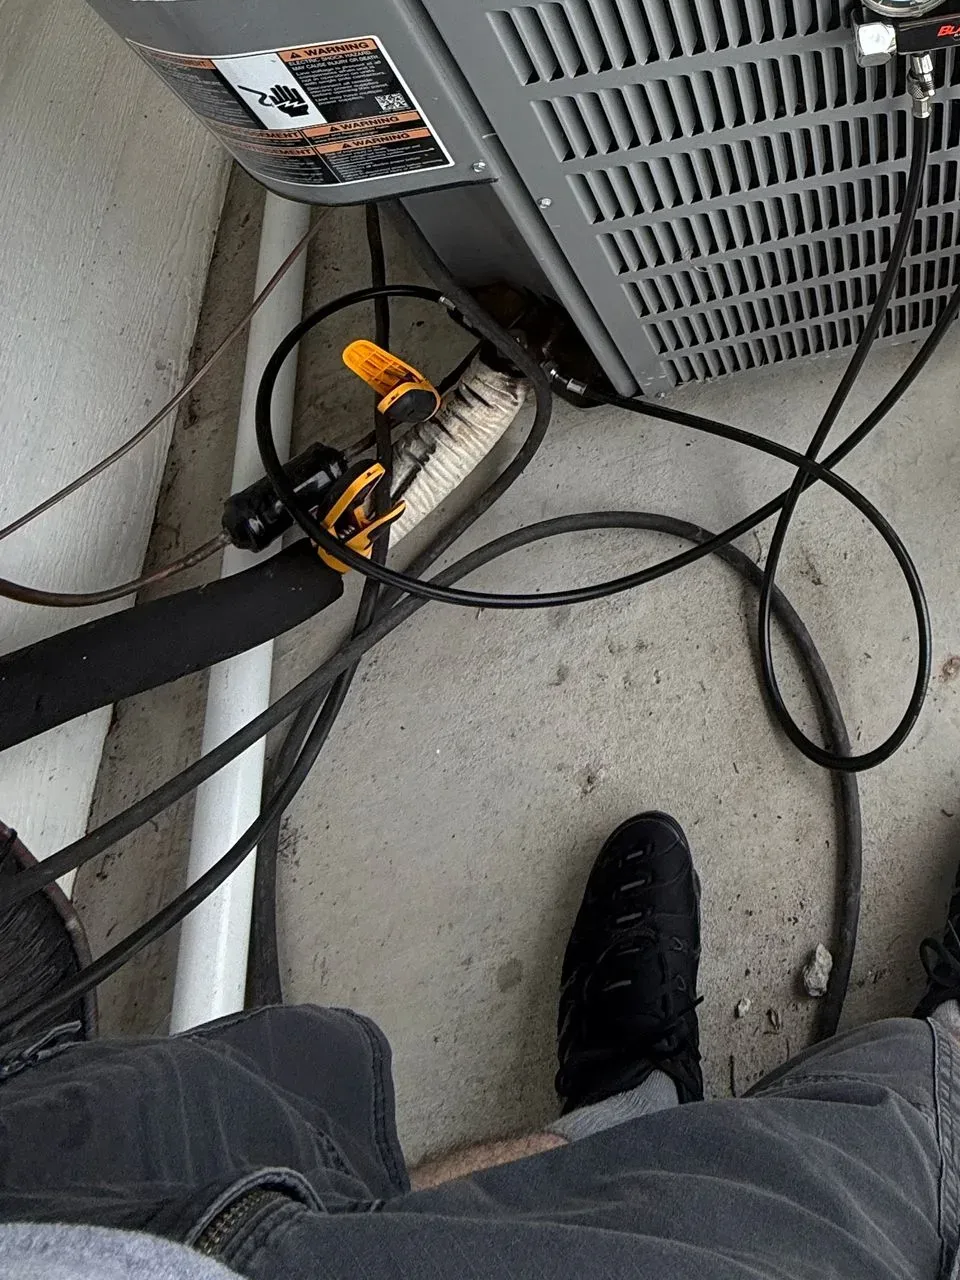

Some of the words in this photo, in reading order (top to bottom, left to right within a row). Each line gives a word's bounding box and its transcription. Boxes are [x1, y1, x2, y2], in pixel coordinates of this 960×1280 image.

[304, 42, 369, 57] WARNING
[340, 116, 401, 130] WARNING
[351, 133, 411, 147] WARNING
